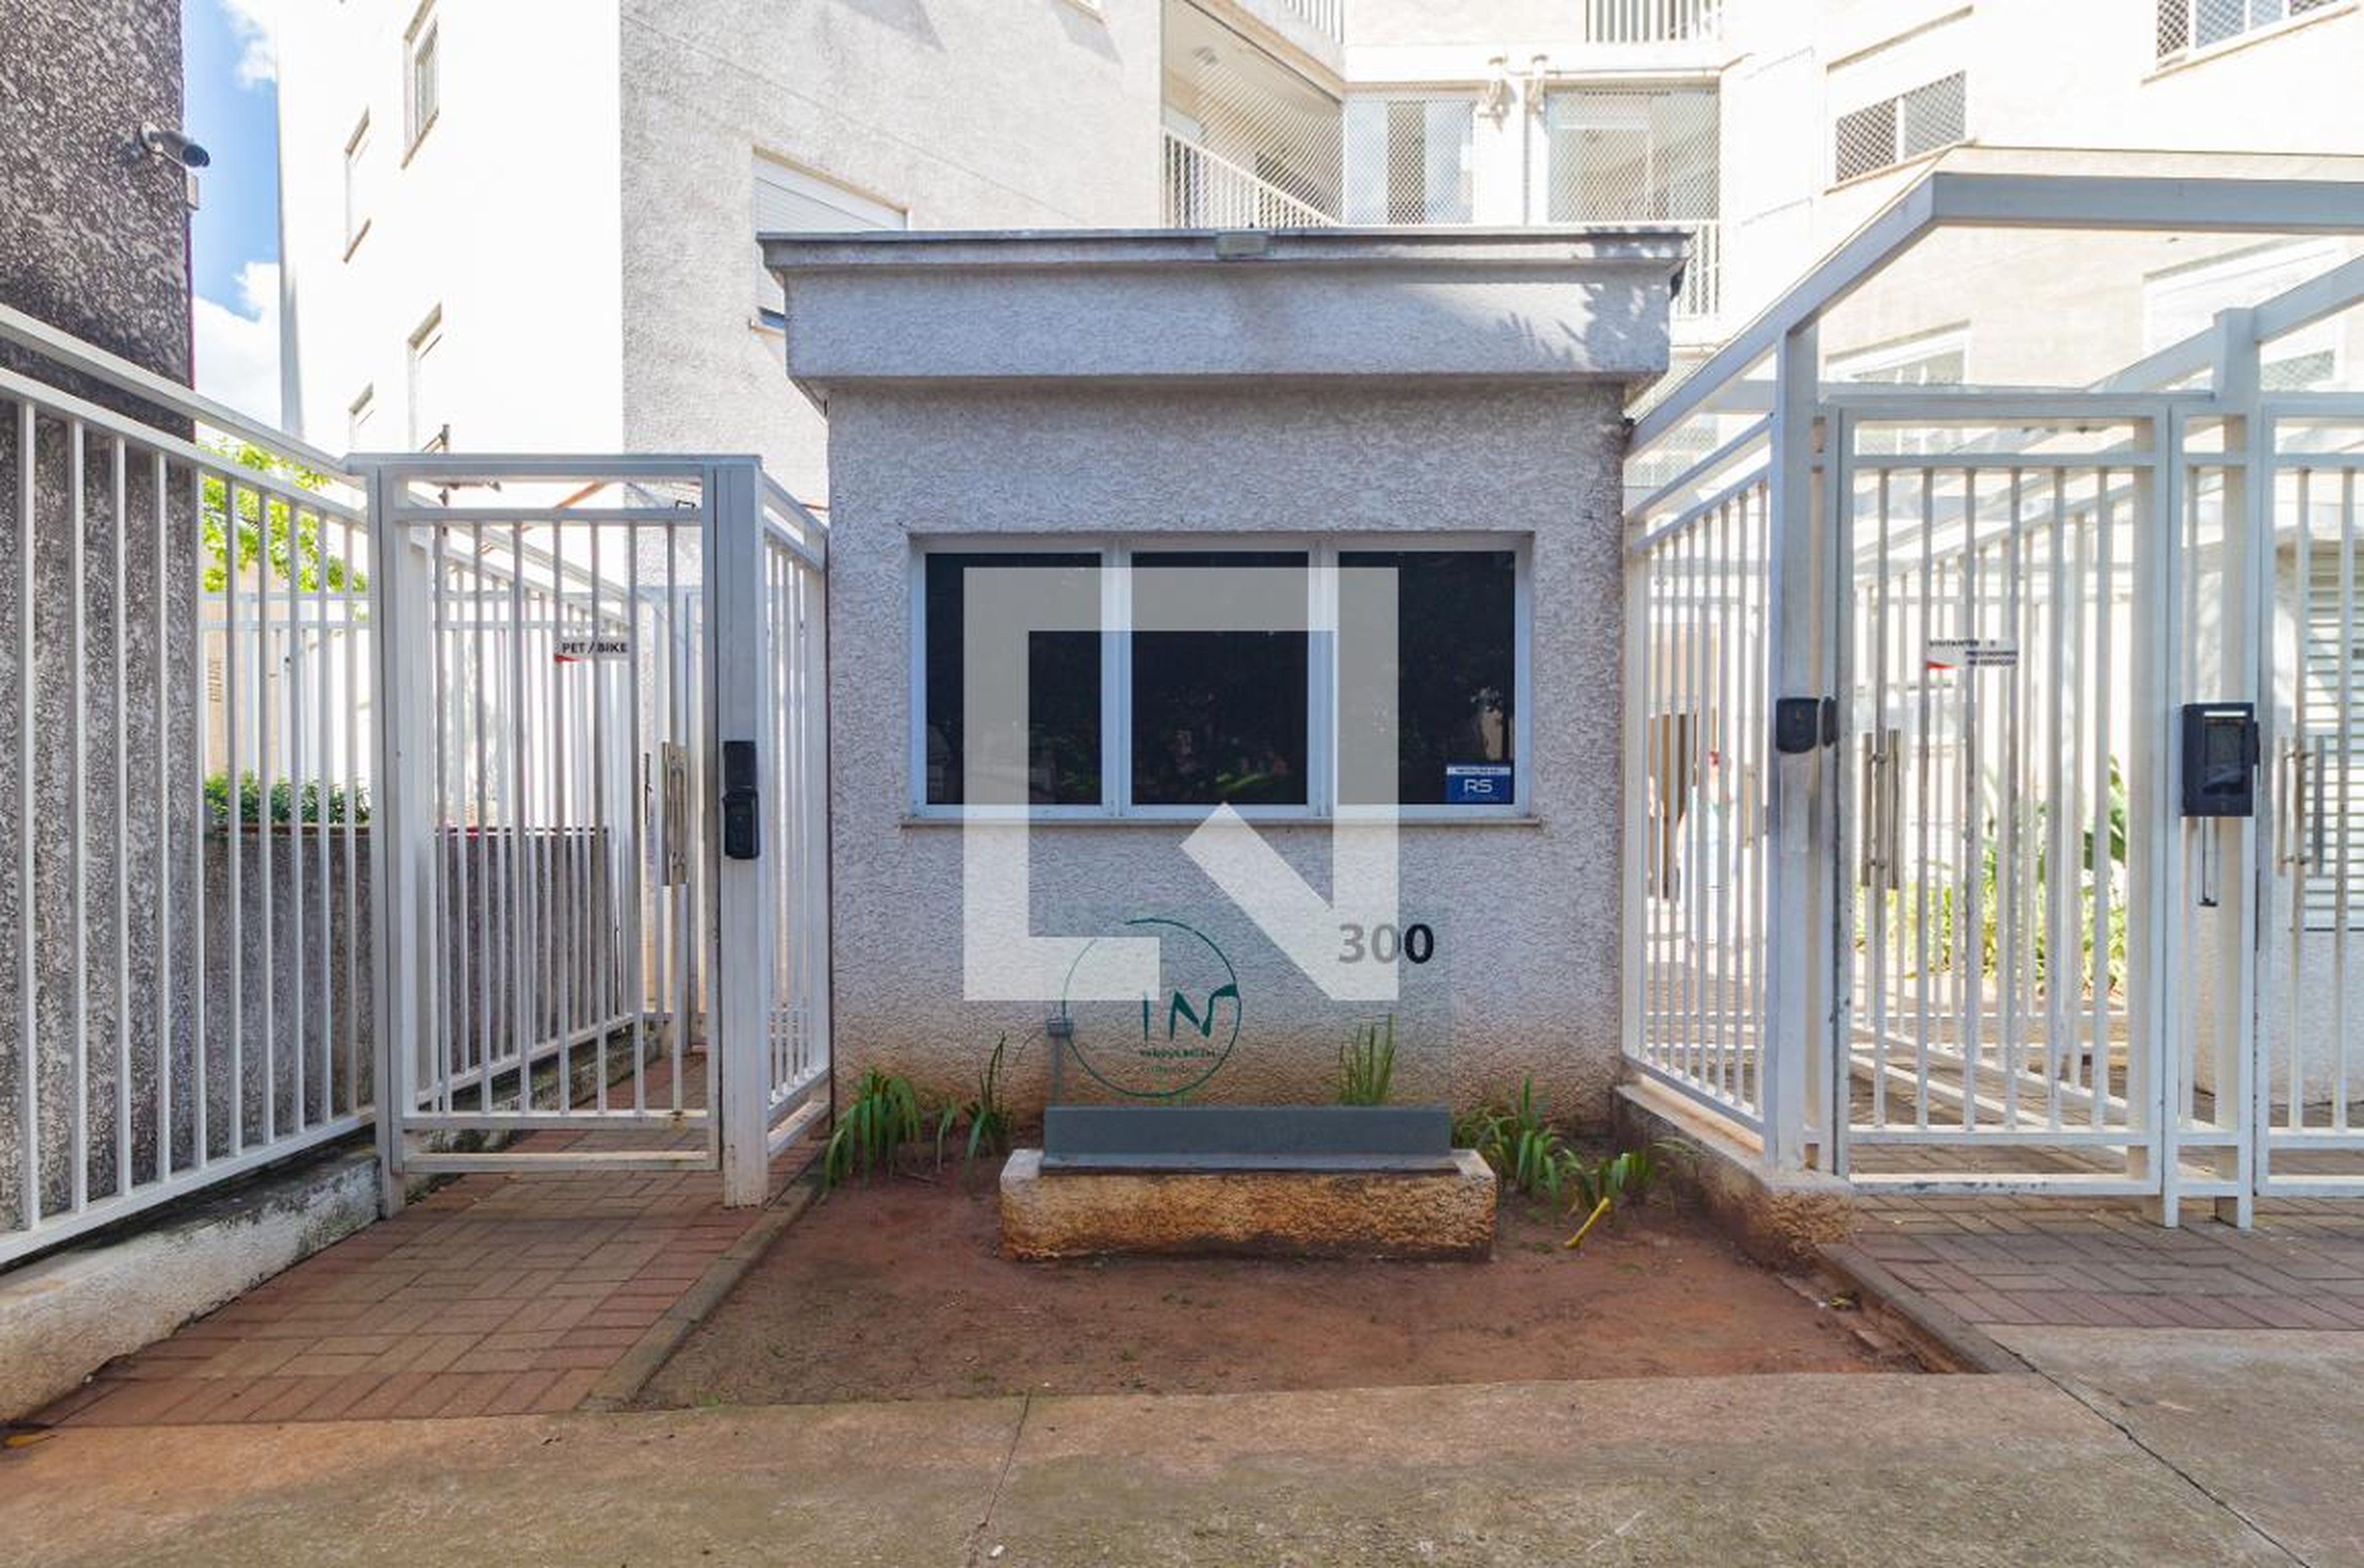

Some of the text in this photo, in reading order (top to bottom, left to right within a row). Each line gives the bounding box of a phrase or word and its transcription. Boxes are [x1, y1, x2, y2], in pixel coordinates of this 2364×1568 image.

[562, 642, 585, 653] PET
[597, 642, 627, 653] BIKE
[1464, 779, 1493, 793] RS
[1339, 924, 1433, 963] 300
